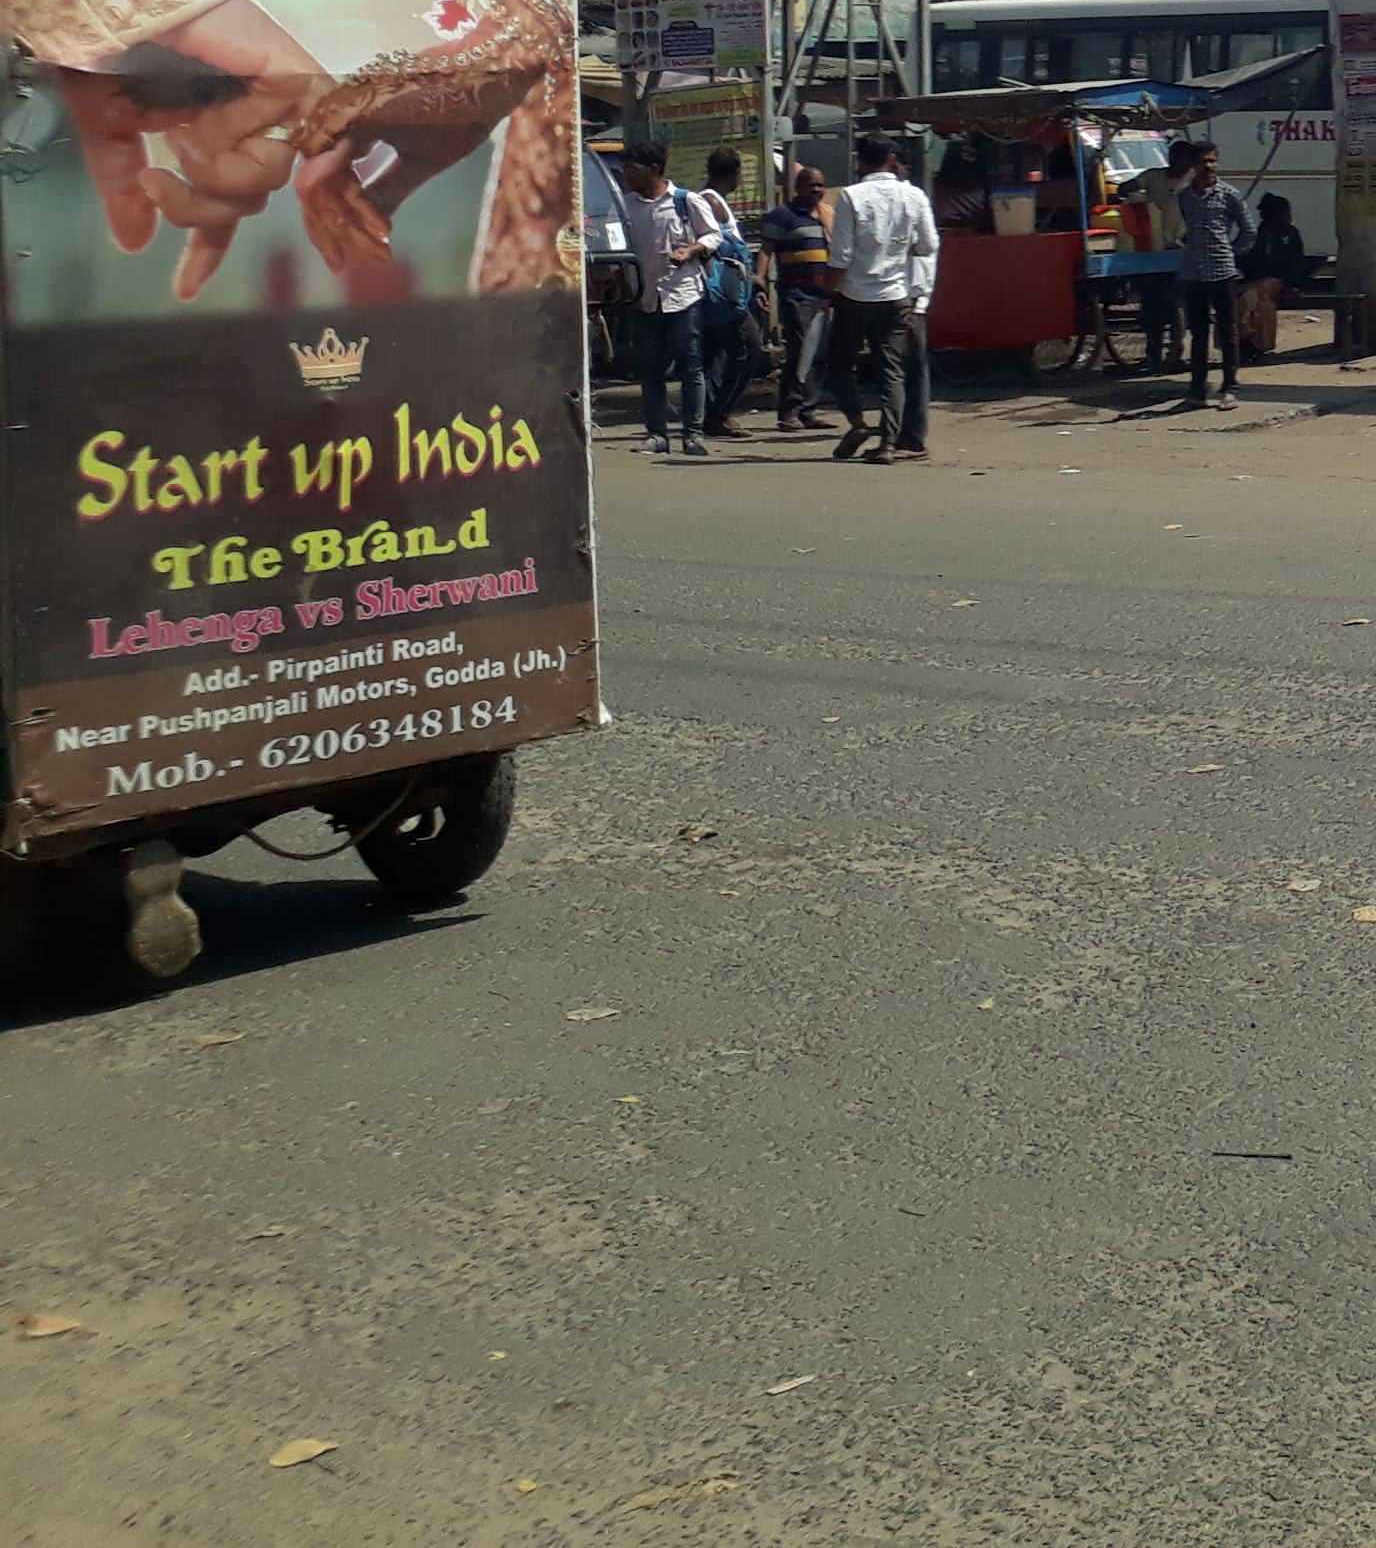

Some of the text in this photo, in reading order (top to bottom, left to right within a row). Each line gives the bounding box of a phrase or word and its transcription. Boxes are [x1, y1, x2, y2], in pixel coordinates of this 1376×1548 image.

[77, 402, 543, 520] Start up India
[153, 507, 490, 591] The Brand
[88, 557, 538, 659] Lehenga vs Sherwani
[55, 645, 567, 753] Near Pushpanjali Motors, Godda (Jh.)
[182, 631, 464, 697] Add.- Pirpainti Road,
[105, 695, 518, 798] Mob.- 6206348184
